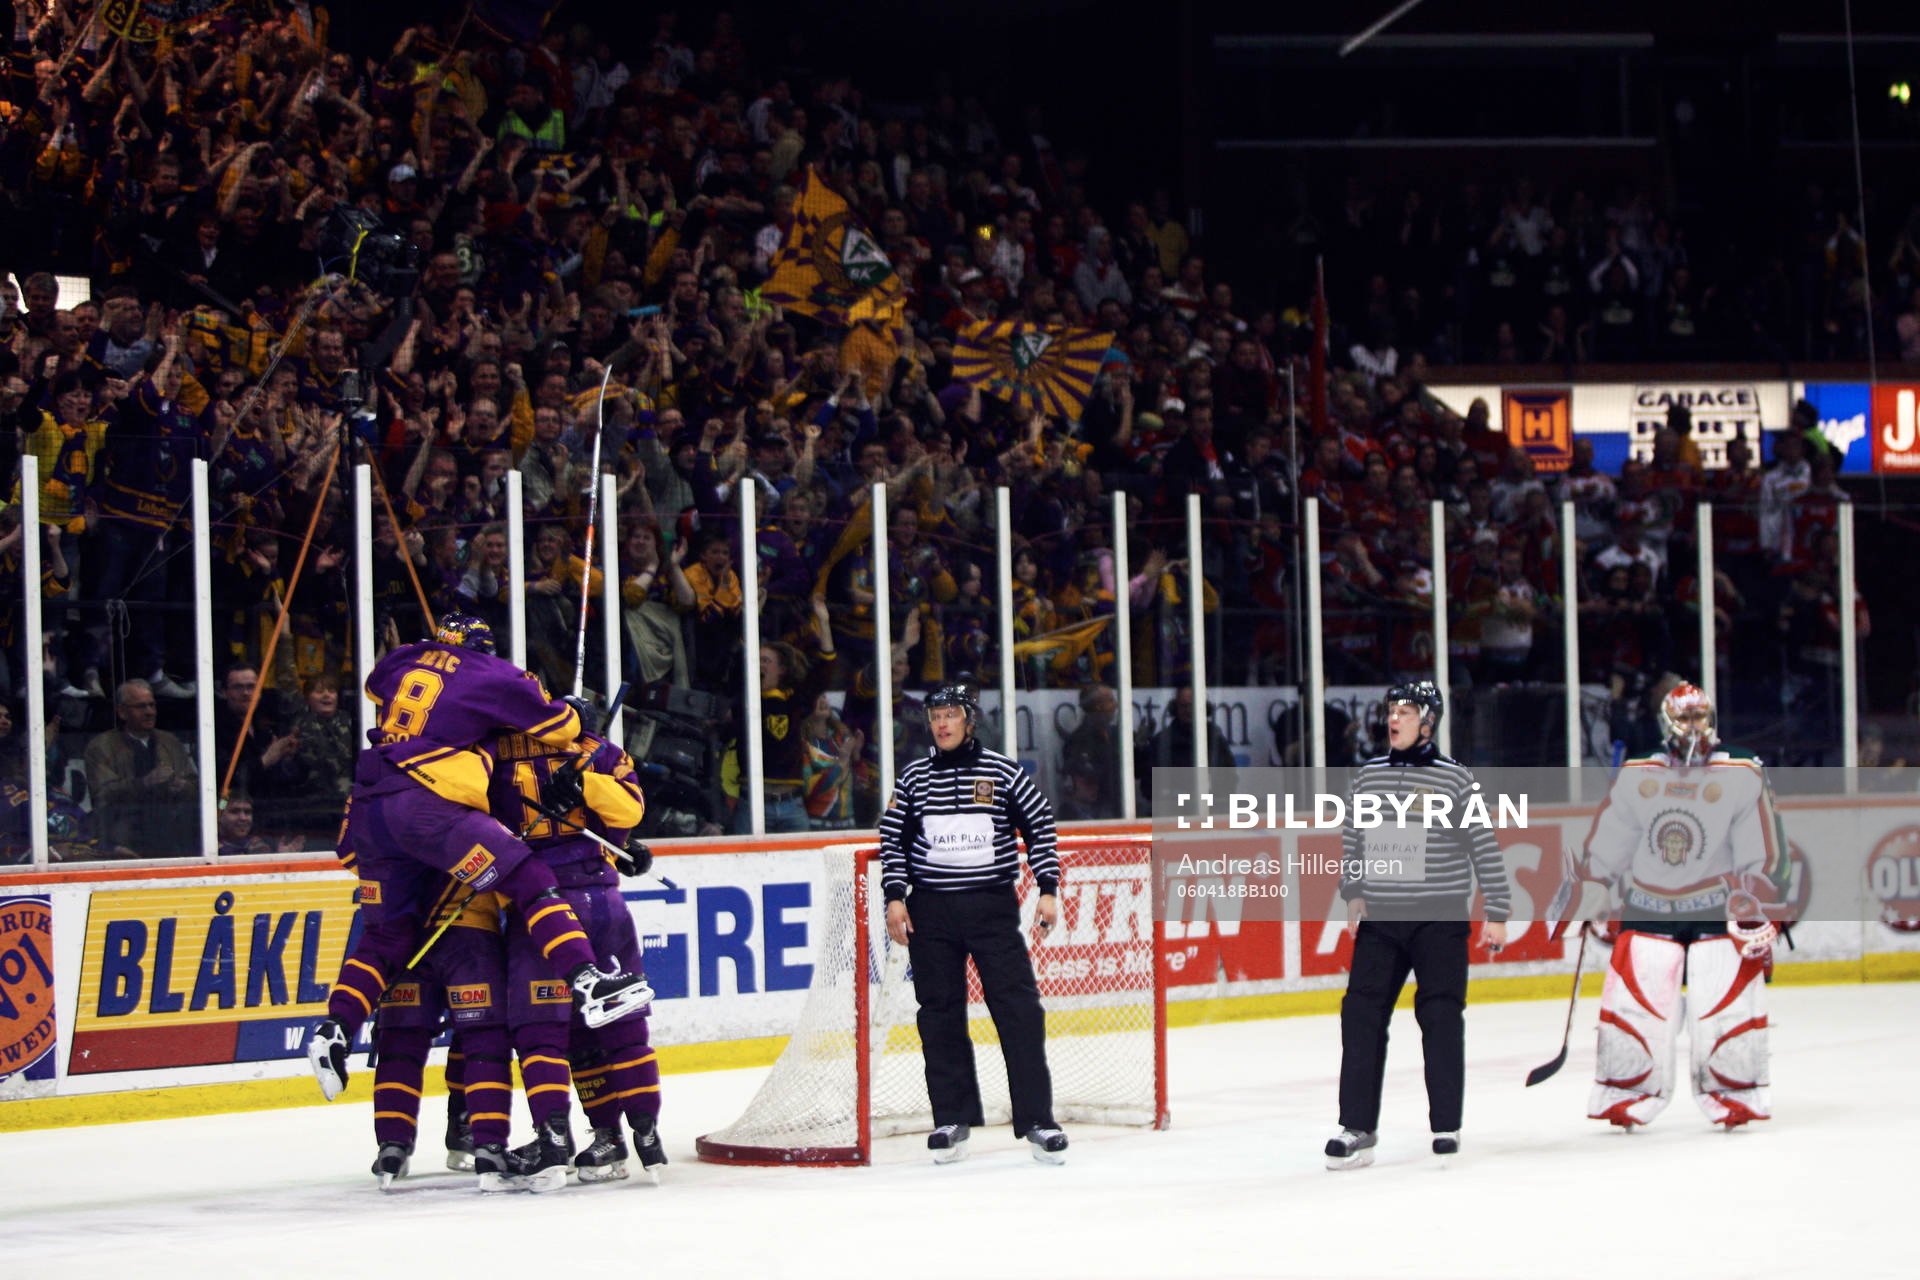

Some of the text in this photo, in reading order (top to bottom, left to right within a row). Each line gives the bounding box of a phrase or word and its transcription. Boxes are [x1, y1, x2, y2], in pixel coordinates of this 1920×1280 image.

[1637, 391, 1751, 406] GARAGE
[1883, 389, 1920, 451] J
[382, 668, 445, 736] 8
[932, 833, 989, 845] FAIR PLAY
[454, 851, 487, 880] ELON
[0, 910, 52, 935] RUK
[97, 890, 362, 1018] BLÅKL
[450, 989, 487, 1004] ELON
